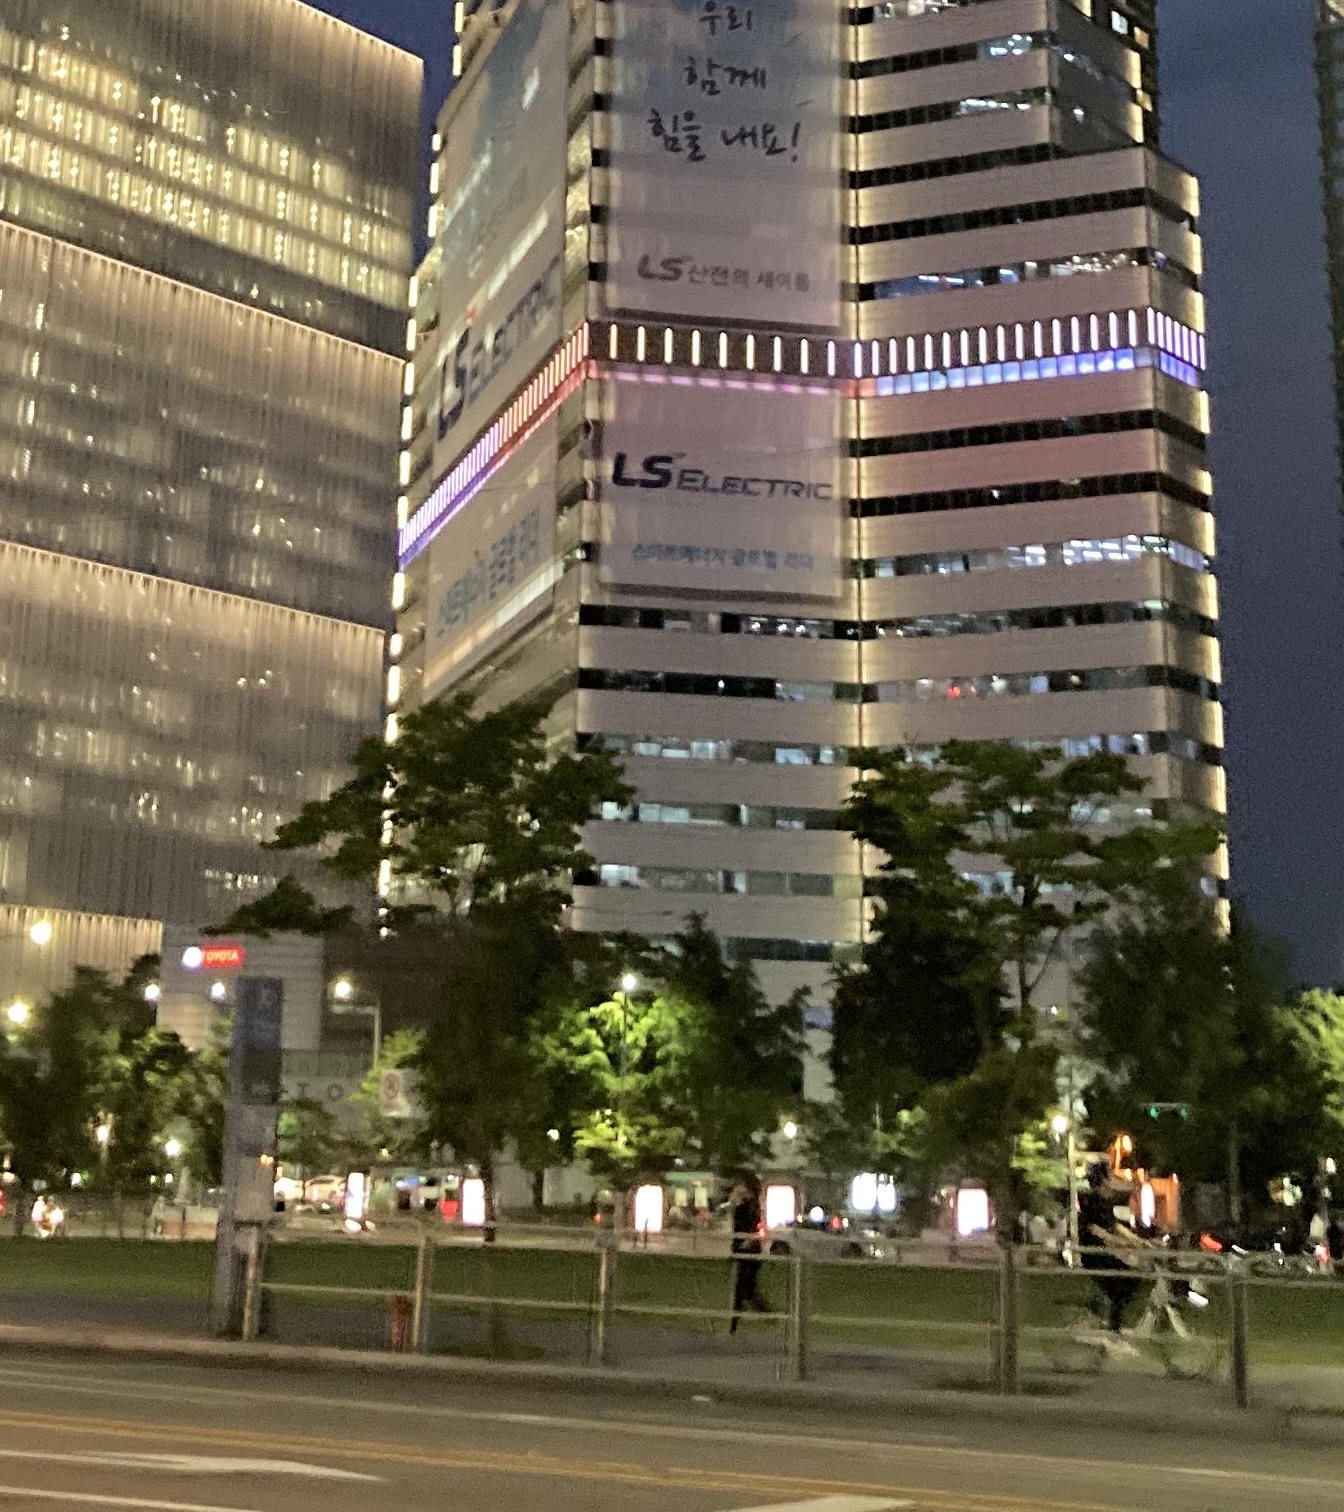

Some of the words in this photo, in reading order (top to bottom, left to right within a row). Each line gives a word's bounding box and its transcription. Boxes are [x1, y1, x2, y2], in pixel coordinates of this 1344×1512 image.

[698, 0, 752, 36] 우리
[683, 55, 767, 96] 함께
[647, 107, 706, 162] 힘을
[612, 452, 674, 489] LS
[676, 468, 833, 502] ELECTRIC
